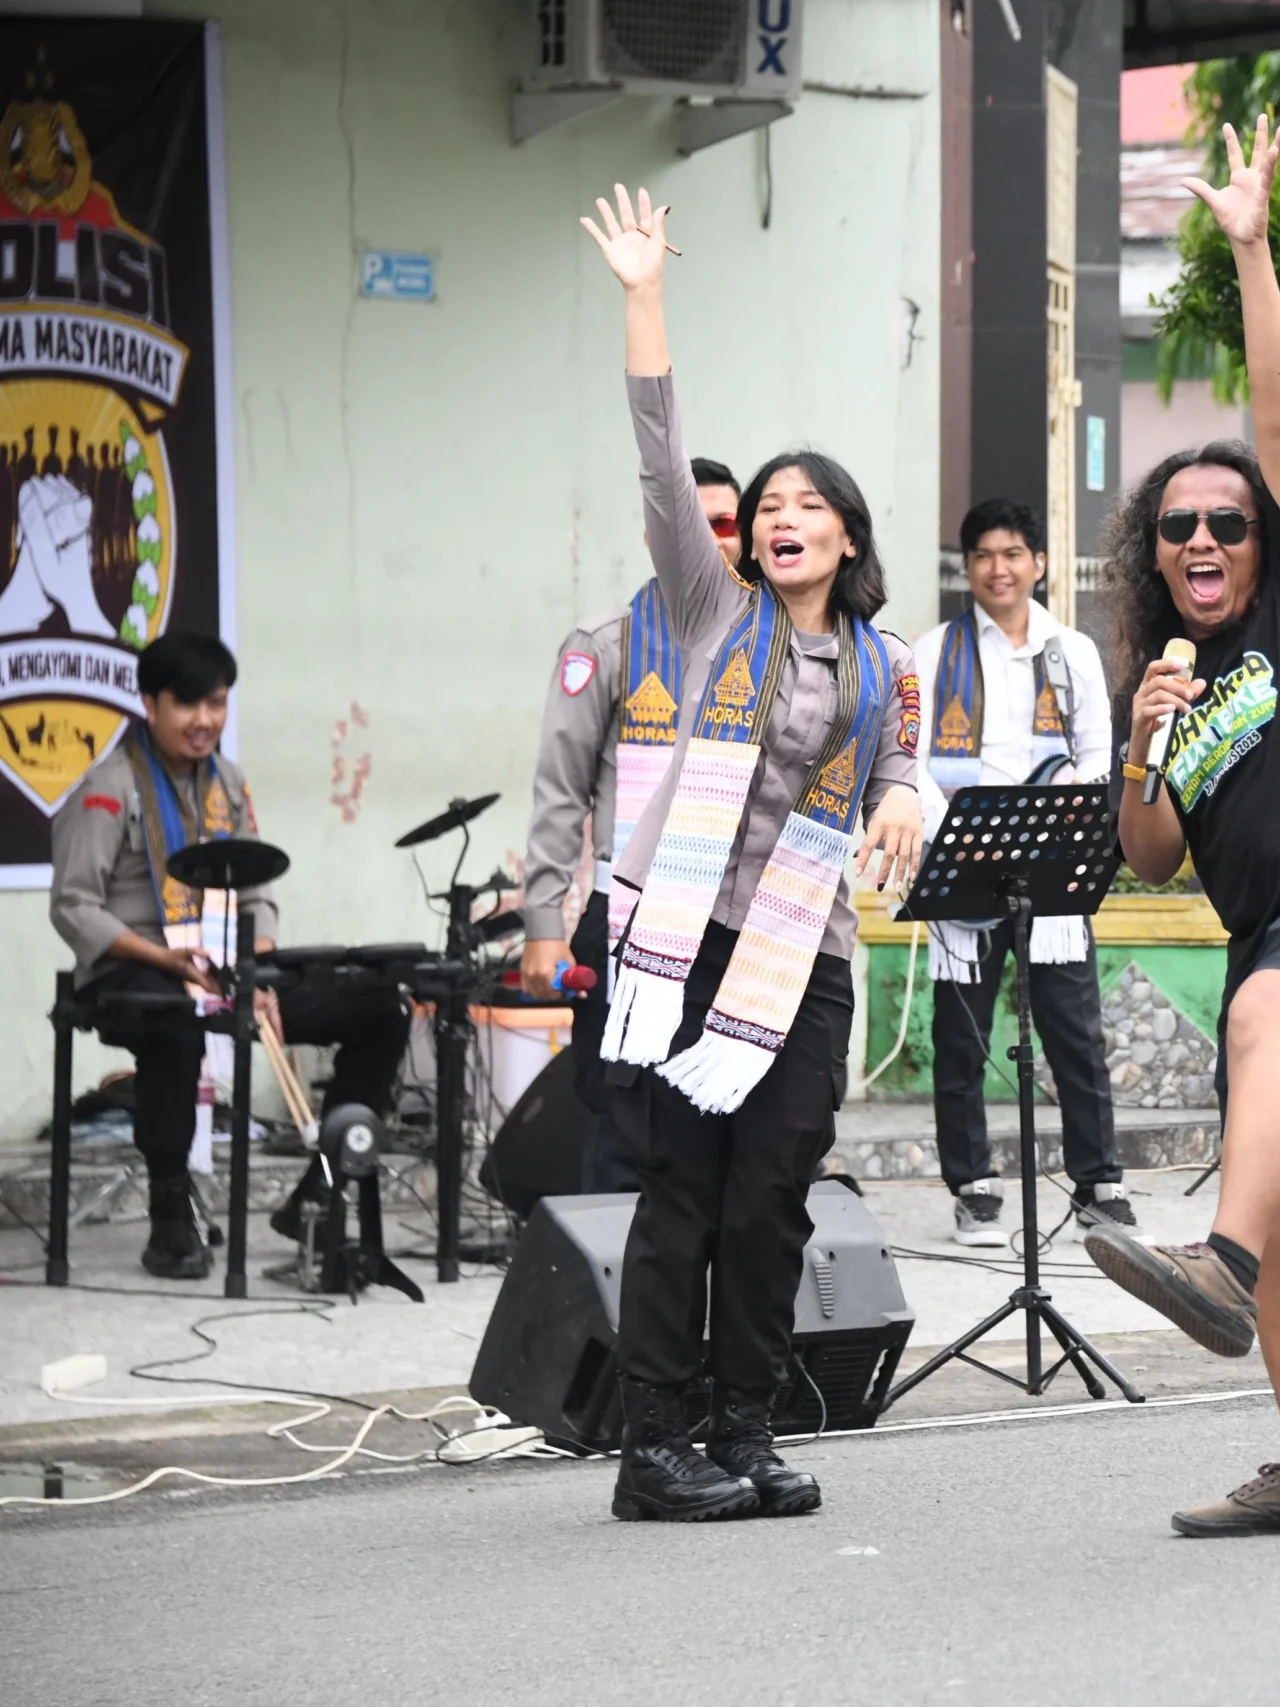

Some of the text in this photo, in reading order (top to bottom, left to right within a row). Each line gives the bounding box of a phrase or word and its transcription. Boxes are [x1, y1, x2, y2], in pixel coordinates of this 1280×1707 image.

[35, 317, 173, 394] MASYARAKAT
[8, 650, 81, 681] MENGAYOMI
[85, 653, 110, 685] DAN
[112, 660, 139, 697] MEL
[704, 706, 754, 727] HORAS
[622, 725, 677, 742] HORAS
[1236, 730, 1261, 755] 2025
[805, 787, 850, 818] HORAS
